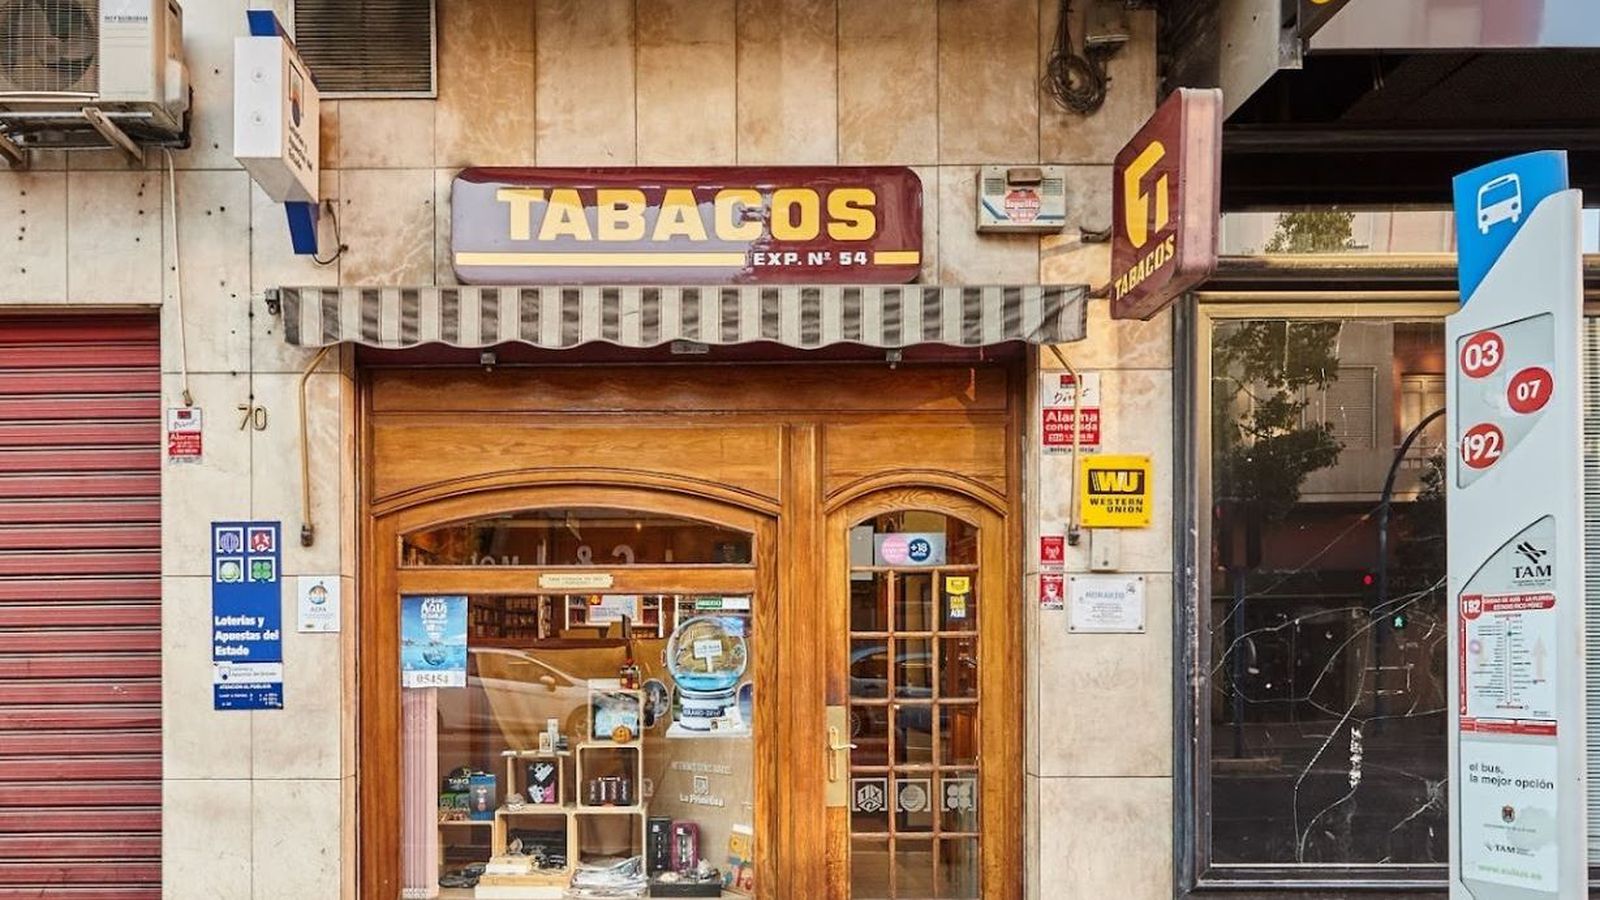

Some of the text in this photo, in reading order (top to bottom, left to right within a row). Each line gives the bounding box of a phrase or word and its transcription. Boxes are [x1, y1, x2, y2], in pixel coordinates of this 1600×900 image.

[496, 187, 877, 242] TABACOS
[753, 251, 803, 266] EXP.
[839, 251, 868, 266] 54
[1114, 233, 1175, 300] TABACOS
[1464, 339, 1499, 371] 03
[1516, 379, 1542, 401] 07
[238, 405, 267, 431] 70
[1462, 430, 1500, 464] 192
[1091, 471, 1139, 493] WU
[1090, 498, 1143, 506] WESTERN
[911, 543, 928, 553] +18
[1512, 565, 1551, 578] TAM
[257, 616, 265, 628] y
[215, 629, 279, 643] Apuestas del
[215, 645, 250, 656] Estado
[1469, 762, 1478, 772] el
[1469, 773, 1554, 790] la mejor opción
[1495, 844, 1516, 854] TAM
